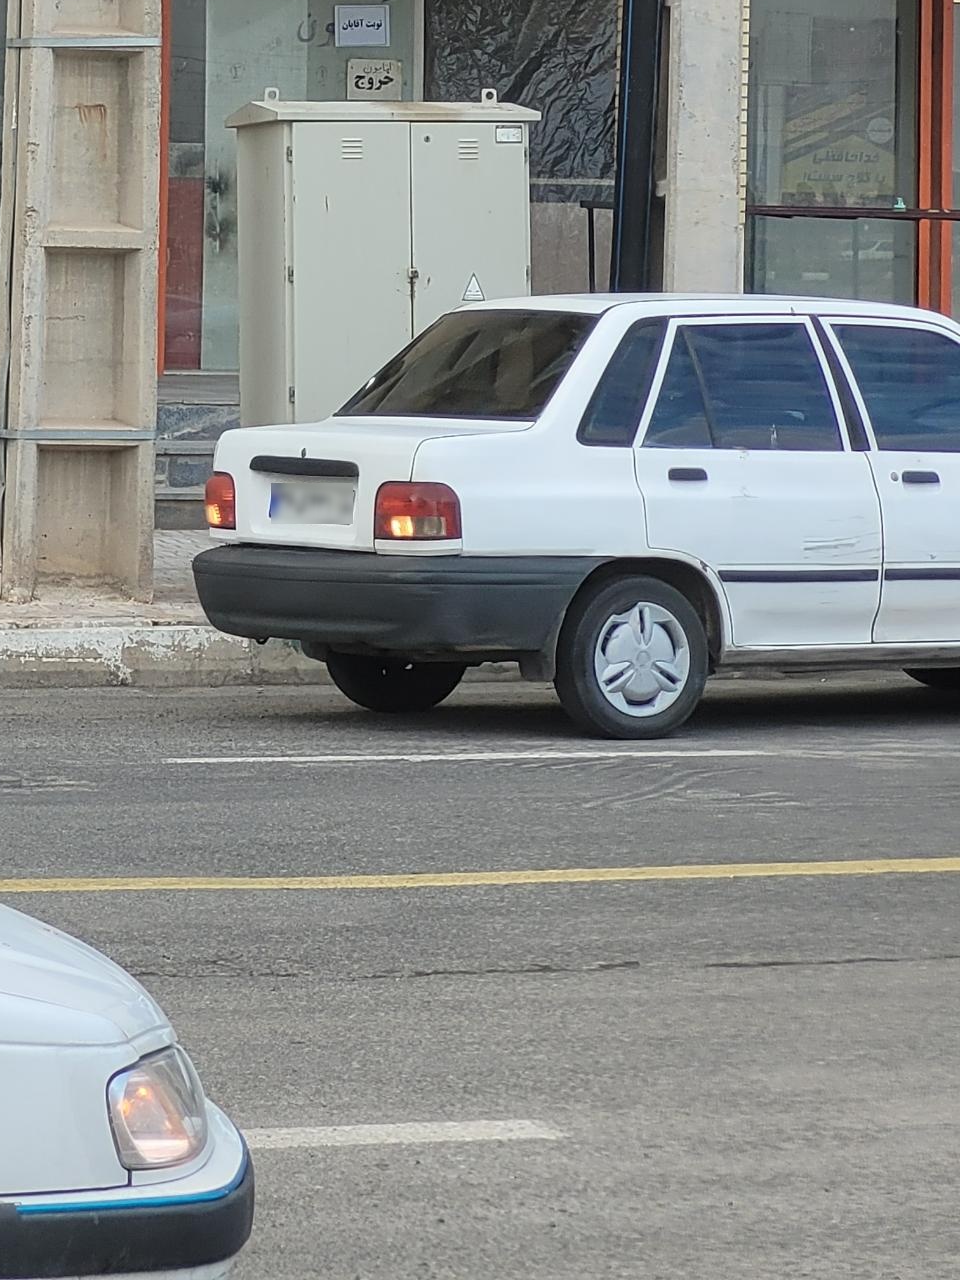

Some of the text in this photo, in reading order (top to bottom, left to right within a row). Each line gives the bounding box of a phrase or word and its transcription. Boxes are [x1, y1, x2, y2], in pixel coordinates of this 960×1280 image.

[342, 18, 382, 30] نوبت آقایان
[354, 73, 394, 90] خروج
